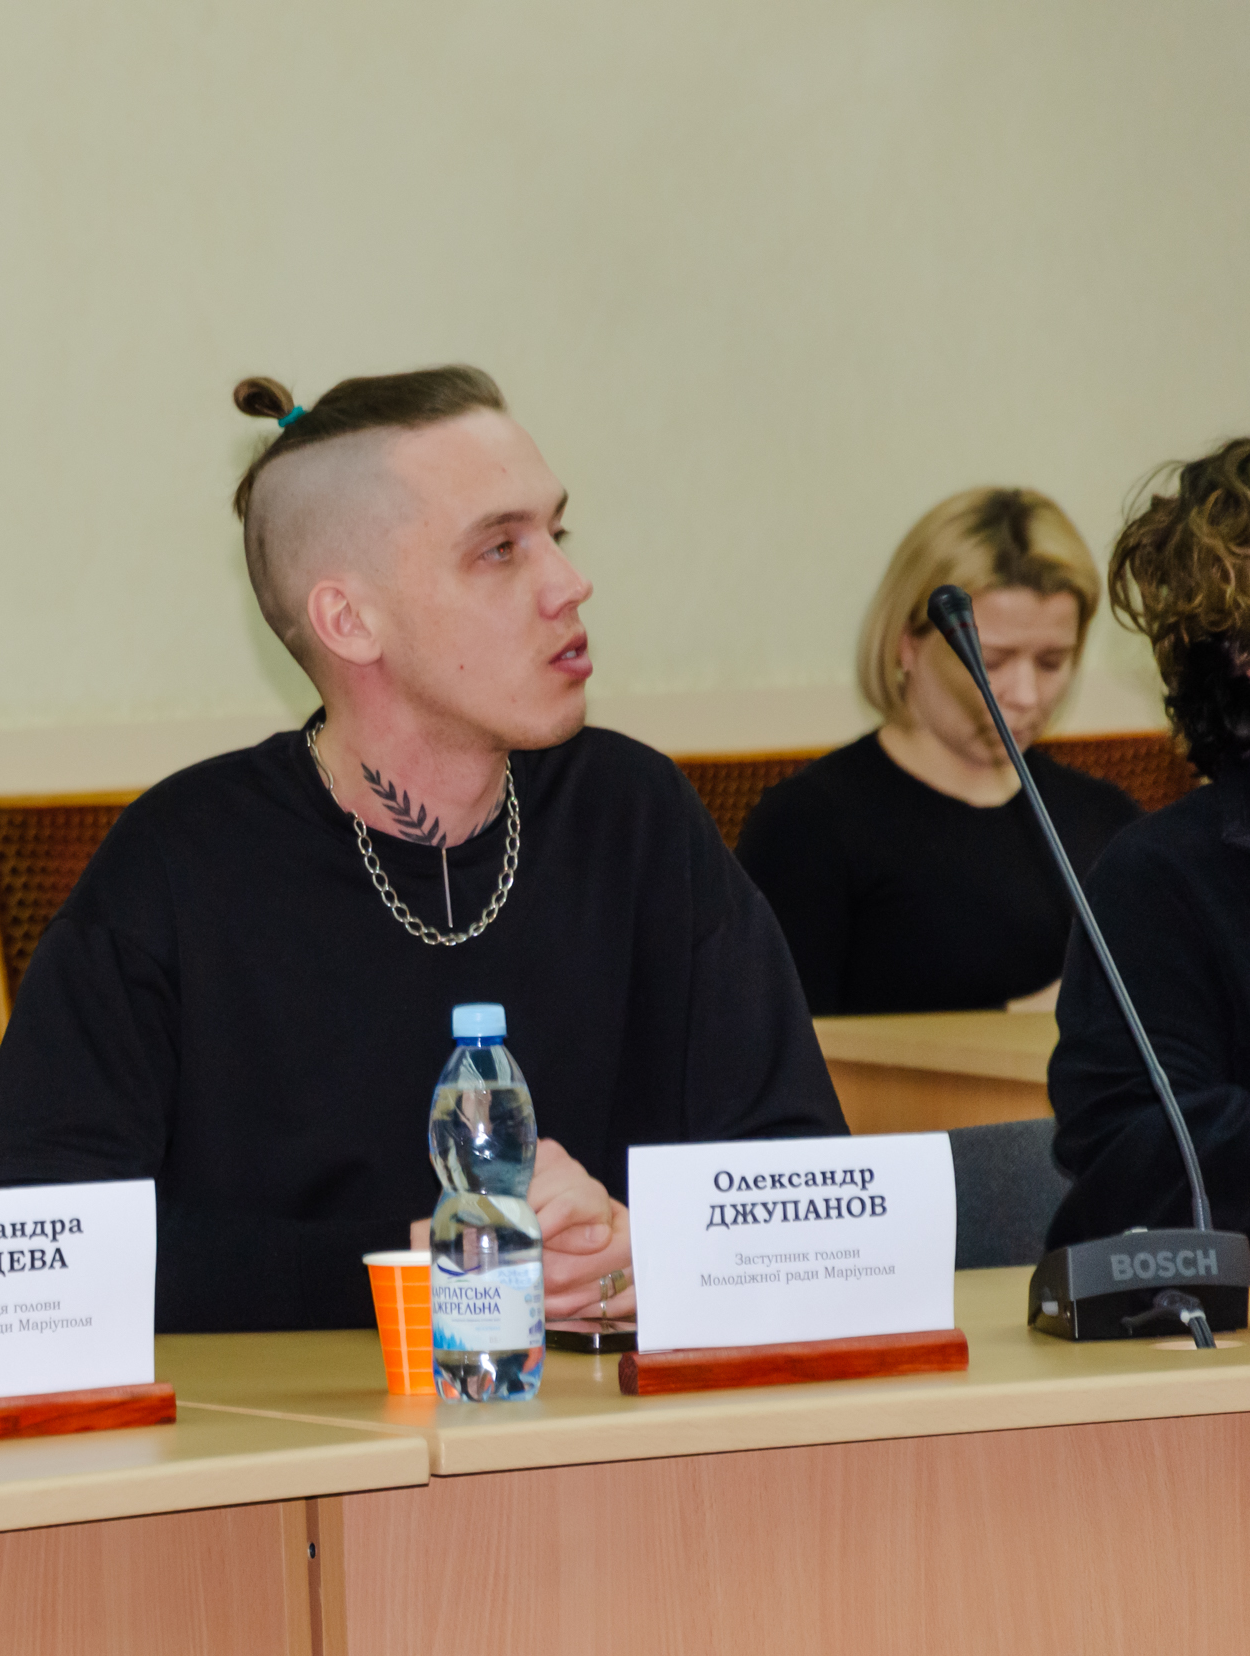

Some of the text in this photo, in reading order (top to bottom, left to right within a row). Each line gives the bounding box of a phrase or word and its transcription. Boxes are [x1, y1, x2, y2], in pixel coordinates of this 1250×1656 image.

[713, 1167, 875, 1193] Олександр
[706, 1195, 888, 1231] ДЖУПАНОВ
[734, 1248, 861, 1267] Заступник голови
[1110, 1249, 1219, 1281] BOSCH
[700, 1264, 896, 1287] Молодіжної ради Маріуполя
[13, 1300, 61, 1314] голови
[18, 1316, 93, 1334] Маріуполя
